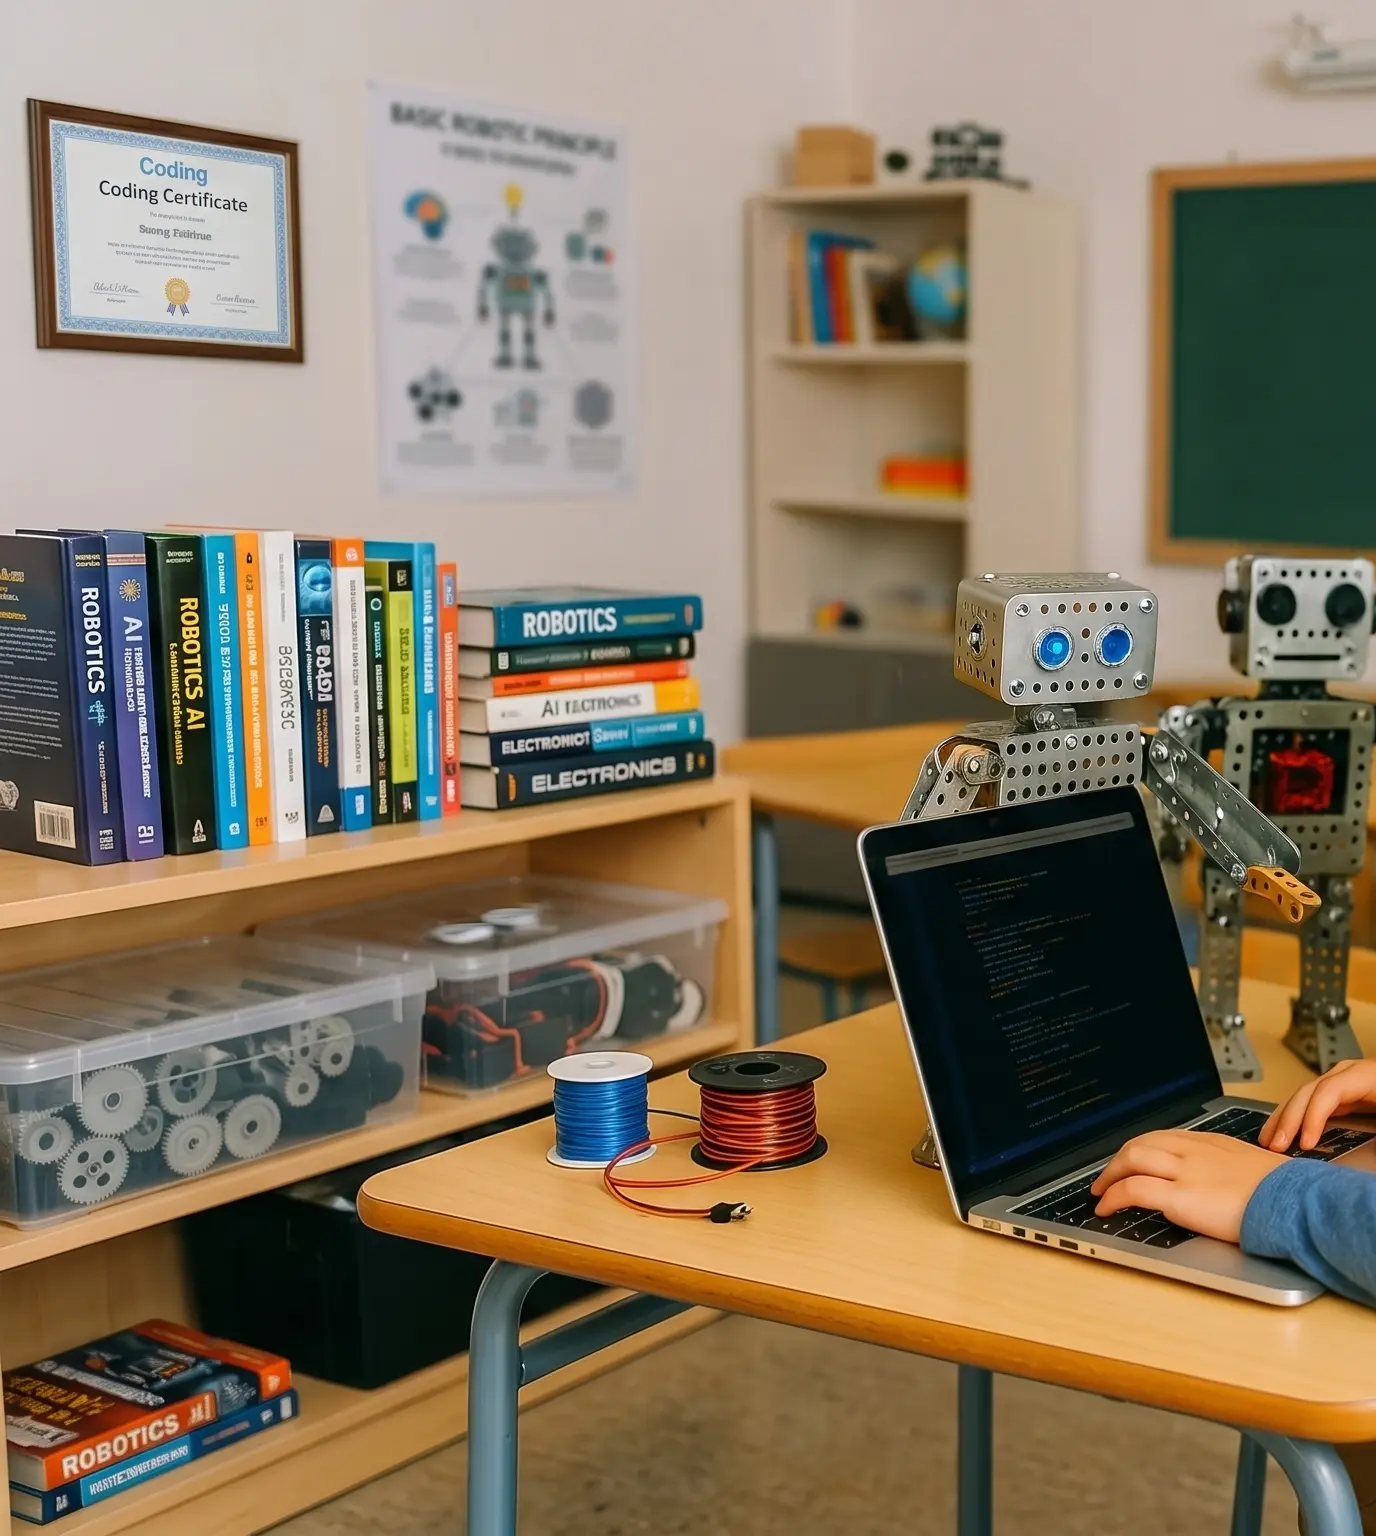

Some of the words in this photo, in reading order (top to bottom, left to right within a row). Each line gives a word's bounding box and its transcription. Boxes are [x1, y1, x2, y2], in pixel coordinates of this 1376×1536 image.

[139, 156, 208, 186] Coding
[99, 180, 158, 205] Coding
[163, 188, 248, 212] Certificate
[123, 616, 143, 642] AI
[523, 607, 617, 638] ROBOTICS
[81, 586, 105, 694] ROBOTICS
[180, 597, 204, 700] ROBOTICS
[185, 706, 206, 730] AI
[541, 699, 559, 717] AI
[61, 1413, 180, 1479] ROBOTICS
